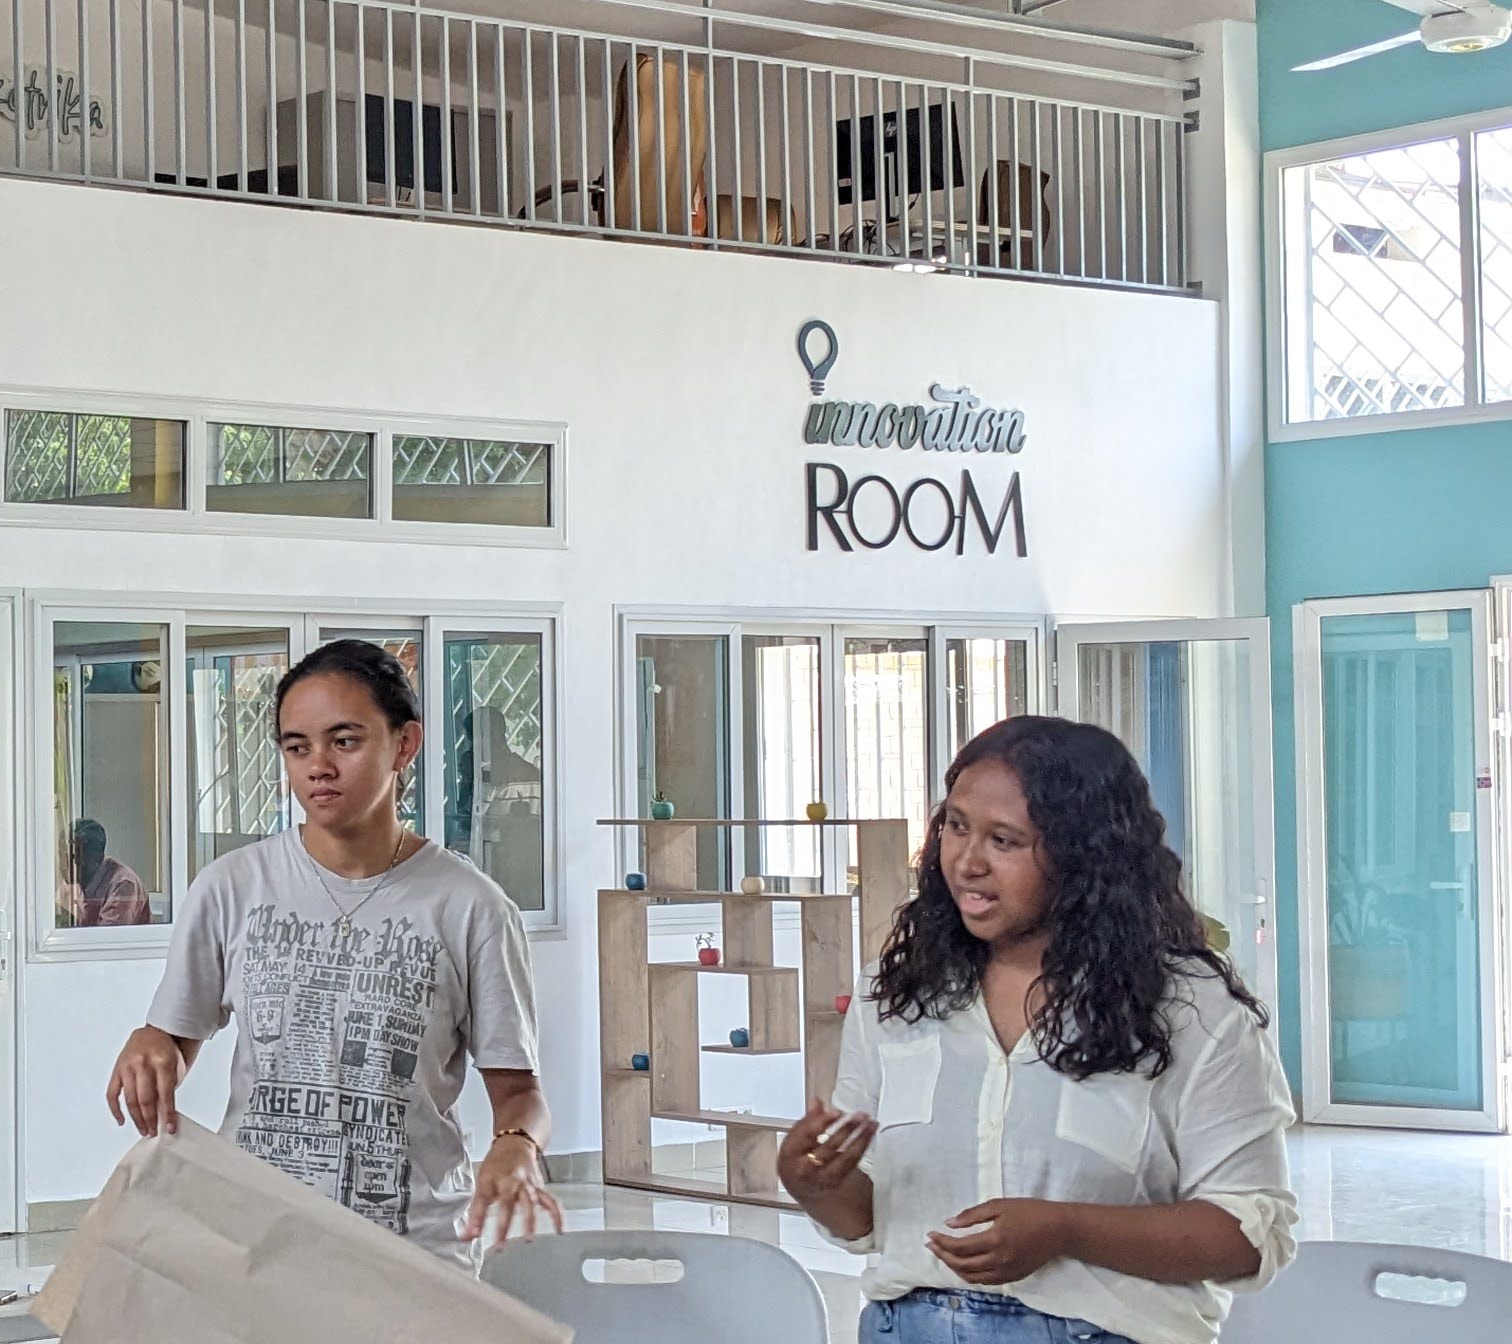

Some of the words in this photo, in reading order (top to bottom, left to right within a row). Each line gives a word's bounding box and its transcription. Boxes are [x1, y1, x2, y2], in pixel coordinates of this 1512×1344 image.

[804, 383, 1028, 455] innovation
[805, 462, 1028, 558] ROOM
[246, 904, 324, 950] Under
[375, 916, 445, 968] Rose
[357, 972, 436, 1008] UNREST
[386, 1015, 427, 1037] SUNDAY
[391, 1033, 419, 1052] SHOW
[304, 1089, 334, 1117] OF
[339, 1094, 406, 1129] POWER
